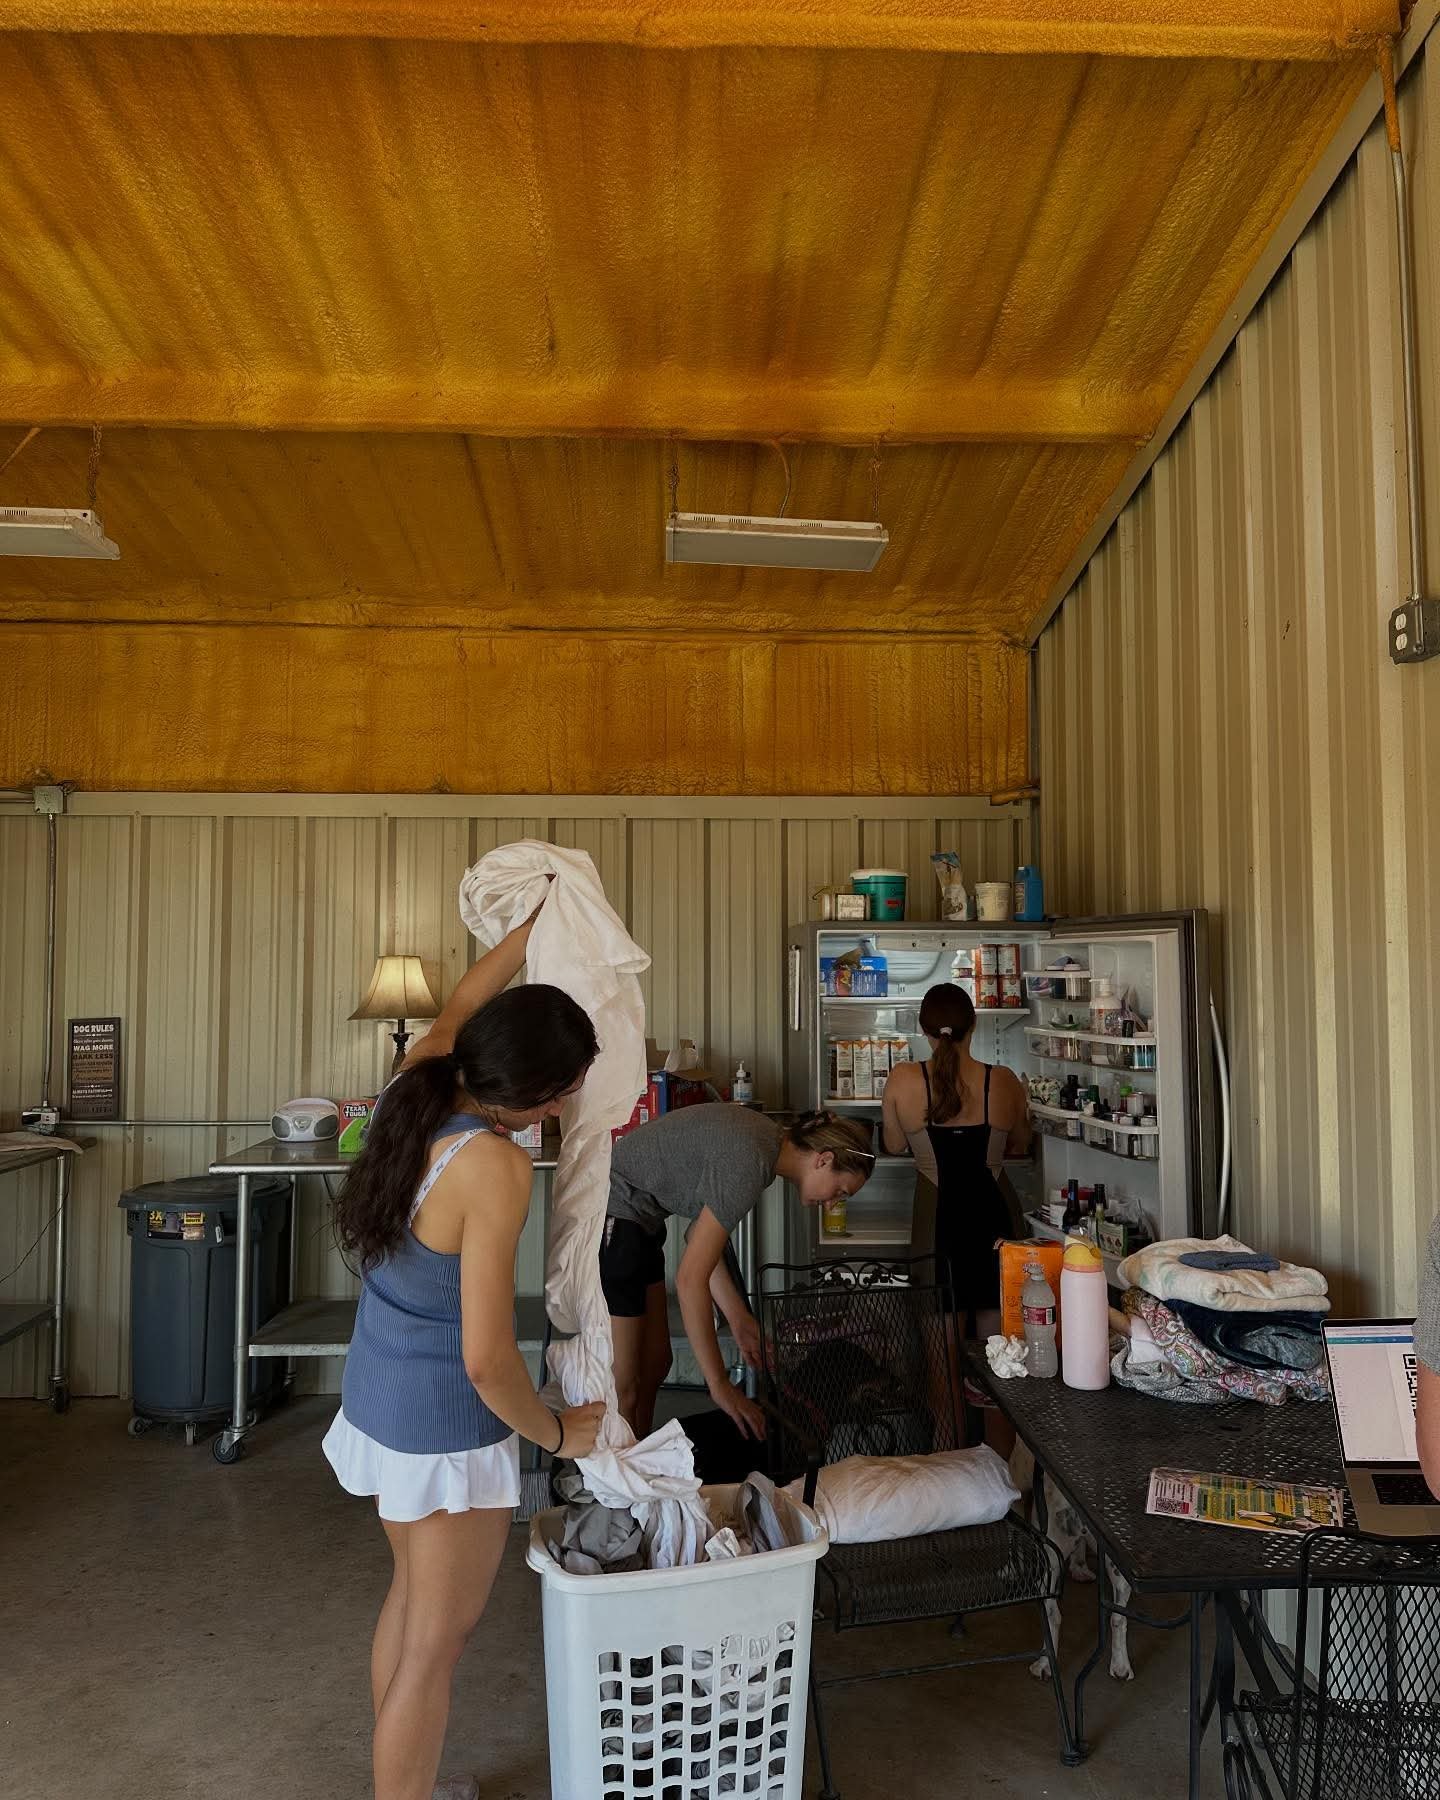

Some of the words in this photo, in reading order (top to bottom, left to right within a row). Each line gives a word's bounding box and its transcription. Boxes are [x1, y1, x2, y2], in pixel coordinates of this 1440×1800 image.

[73, 1025, 90, 1033] DOG
[91, 1024, 114, 1032] RULES
[345, 1104, 366, 1112] TEXAS
[149, 1210, 162, 1221] 3X
